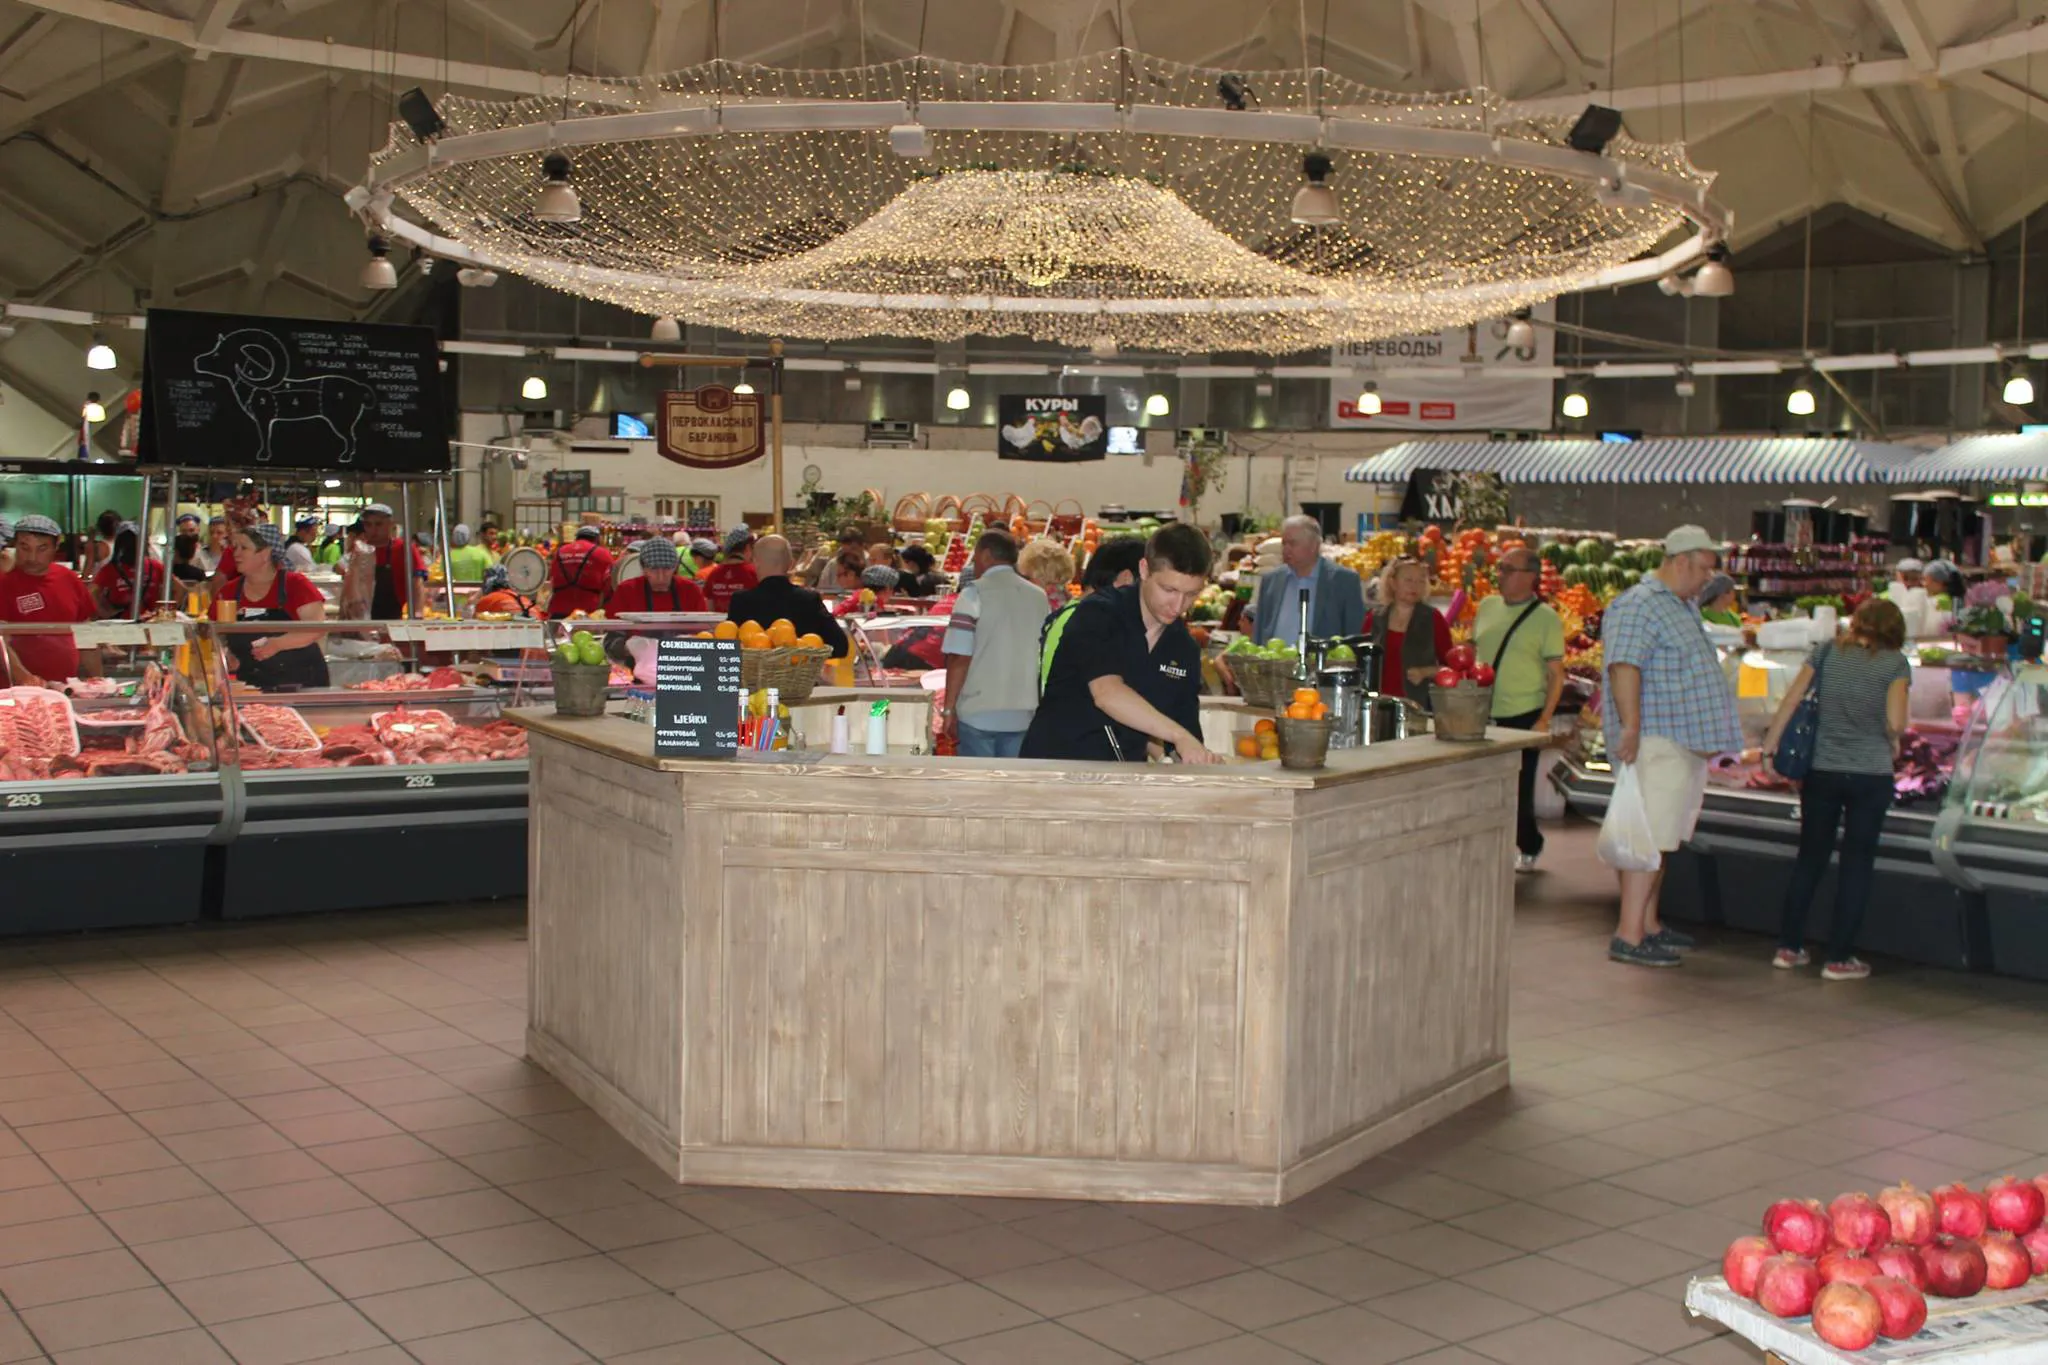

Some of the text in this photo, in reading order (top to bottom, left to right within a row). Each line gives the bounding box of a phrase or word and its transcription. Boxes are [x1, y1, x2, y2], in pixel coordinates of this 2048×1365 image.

[1339, 340, 1443, 358] ПЕРЕВОДЫ
[1025, 398, 1079, 411] КУРЫ
[672, 416, 753, 427] ПЕРВОКЛАССНАЯ
[688, 431, 738, 443] БАРАНИНА
[660, 641, 715, 649] СВЕЖЕВЫЖАТЫЕ
[674, 713, 707, 724] ШЕЙКИ
[405, 775, 435, 788] 292
[7, 793, 42, 808] 293
